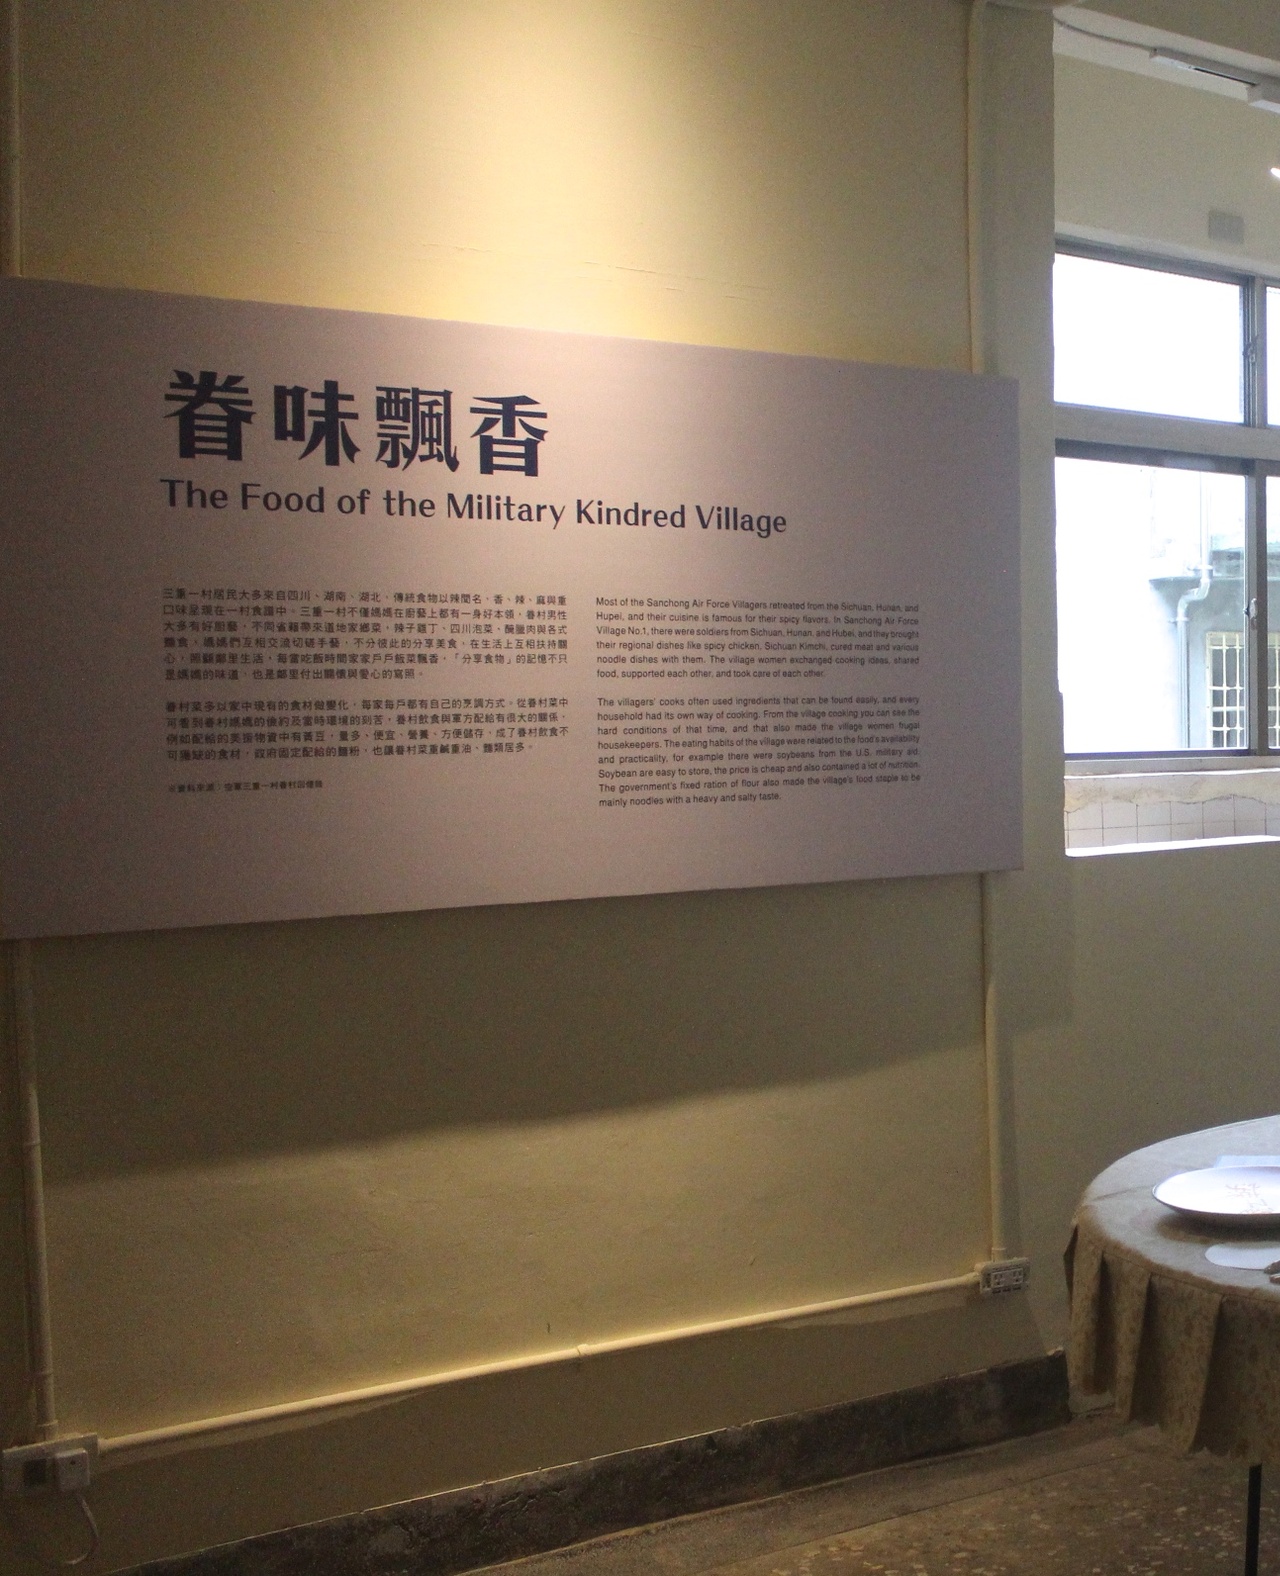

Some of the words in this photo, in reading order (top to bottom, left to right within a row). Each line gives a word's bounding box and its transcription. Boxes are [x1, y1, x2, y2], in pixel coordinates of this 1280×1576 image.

[164, 369, 548, 477] 眷味飄香
[159, 477, 228, 510] The
[241, 482, 325, 516] Food
[336, 487, 372, 517] of
[382, 489, 436, 518] the
[445, 491, 566, 530] Military
[575, 499, 687, 530] Kindred
[694, 505, 788, 536] Village
[596, 597, 618, 606] Most
[620, 598, 628, 606] of
[631, 598, 644, 607] the
[647, 598, 690, 610] Sanchong
[692, 599, 704, 608] Air
[706, 599, 730, 608] Force
[732, 600, 767, 611] Villagers
[769, 601, 805, 610] retreated
[807, 601, 825, 610] from
[827, 602, 839, 610] the
[628, 612, 644, 621] and
[647, 613, 666, 621] their
[669, 613, 699, 622] cuisine
[702, 613, 709, 622] is
[712, 613, 742, 622] famous
[745, 614, 756, 623] for
[758, 614, 777, 623] their
[779, 614, 800, 625] spicy
[596, 626, 626, 637] Village
[651, 627, 673, 635] there
[696, 627, 729, 636] soldiers
[730, 627, 749, 636] from
[596, 640, 616, 649] their
[619, 640, 654, 651] regional
[656, 641, 684, 649] dishes
[687, 641, 702, 650] like
[704, 641, 725, 652] spicy
[765, 642, 797, 650] Sichuan
[597, 655, 627, 663] noodle
[630, 655, 658, 663] dishes
[661, 655, 679, 663] with
[709, 655, 725, 664] The
[728, 655, 755, 666] village
[789, 655, 832, 666] exchanged
[621, 669, 665, 680] supported
[667, 669, 688, 678] each
[716, 669, 732, 678] and
[733, 669, 751, 678] took
[772, 669, 781, 678] of
[597, 697, 615, 706] The
[659, 697, 685, 705] cooks
[688, 697, 709, 705] often
[712, 696, 733, 705] used
[735, 696, 781, 707] ingredients
[783, 696, 799, 705] that
[818, 696, 829, 705] be
[597, 711, 643, 720] household
[646, 711, 662, 720] had
[664, 711, 674, 719] its
[697, 712, 713, 721] way
[716, 710, 724, 719] of
[763, 710, 784, 718] From
[786, 709, 799, 718] the
[800, 709, 826, 720] village
[597, 726, 618, 735] hard
[623, 725, 668, 734] conditions
[672, 725, 681, 734] of
[686, 725, 702, 733] that
[732, 724, 748, 733] and
[753, 723, 769, 732] that
[773, 723, 791, 732] also
[795, 723, 817, 731] made
[663, 739, 681, 748] The
[682, 738, 708, 749] eating
[709, 738, 735, 747] habits
[736, 738, 744, 746] of
[745, 737, 758, 746] the
[759, 737, 785, 748] village
[807, 736, 834, 745] related
[598, 754, 615, 763] and
[672, 753, 684, 761] for
[688, 752, 724, 763] example
[728, 751, 749, 760] there
[776, 750, 815, 761] soybeans
[818, 749, 836, 758] from
[598, 768, 637, 780] Soybean
[639, 769, 653, 777] are
[655, 769, 676, 778] easy
[678, 767, 686, 775] to
[714, 766, 727, 774] the
[729, 765, 750, 776] price
[751, 765, 759, 773] is
[760, 764, 785, 775] cheap
[787, 763, 803, 772] and
[804, 763, 820, 772] also
[599, 783, 616, 792] The
[680, 780, 701, 789] fixed
[704, 779, 727, 788] ration
[730, 779, 739, 788] of
[741, 778, 760, 787] flour
[763, 778, 780, 787] also
[782, 777, 804, 786] made
[807, 776, 820, 785] the
[599, 797, 627, 808] mainly
[630, 796, 664, 805] noodles
[666, 795, 683, 804] with
[693, 794, 718, 805] heavy
[720, 793, 736, 802] and
[738, 792, 757, 804] salty
